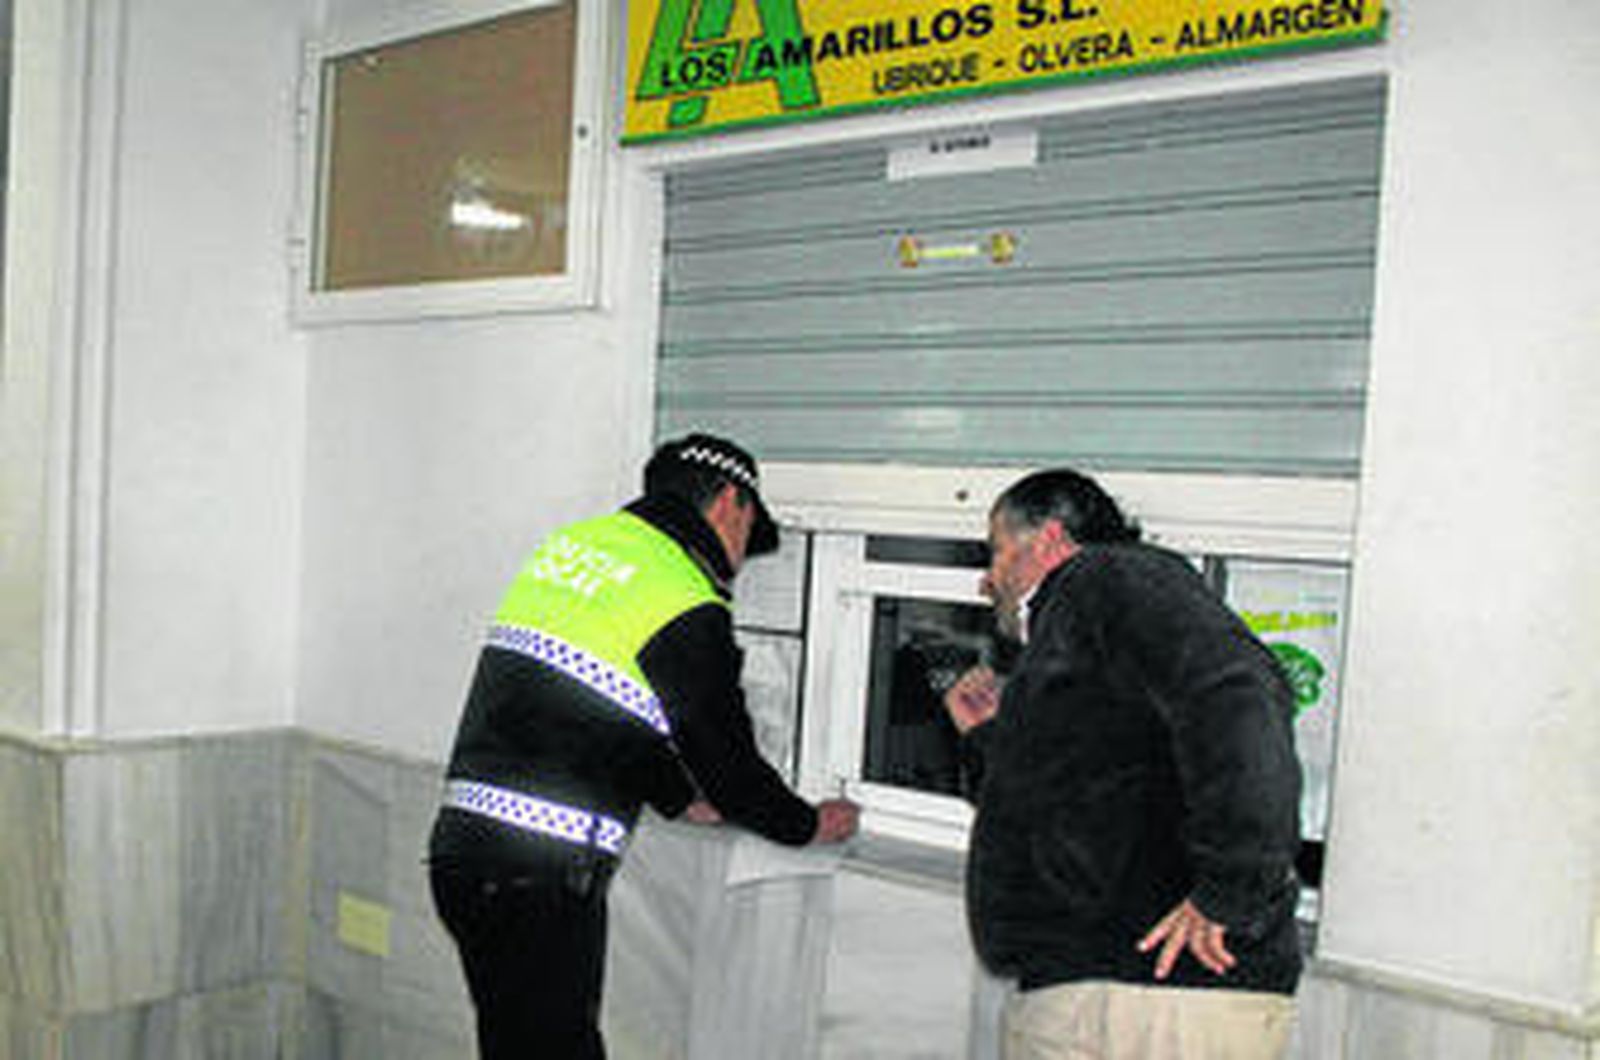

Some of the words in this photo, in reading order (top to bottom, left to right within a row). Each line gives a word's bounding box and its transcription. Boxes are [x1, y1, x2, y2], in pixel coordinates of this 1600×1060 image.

[660, 52, 728, 87] LOS
[753, 4, 994, 72] AMARILLOS
[1016, 0, 1099, 29] S.L.
[1018, 31, 1134, 73] OLVERA
[1174, 0, 1366, 52] ALMARGEN
